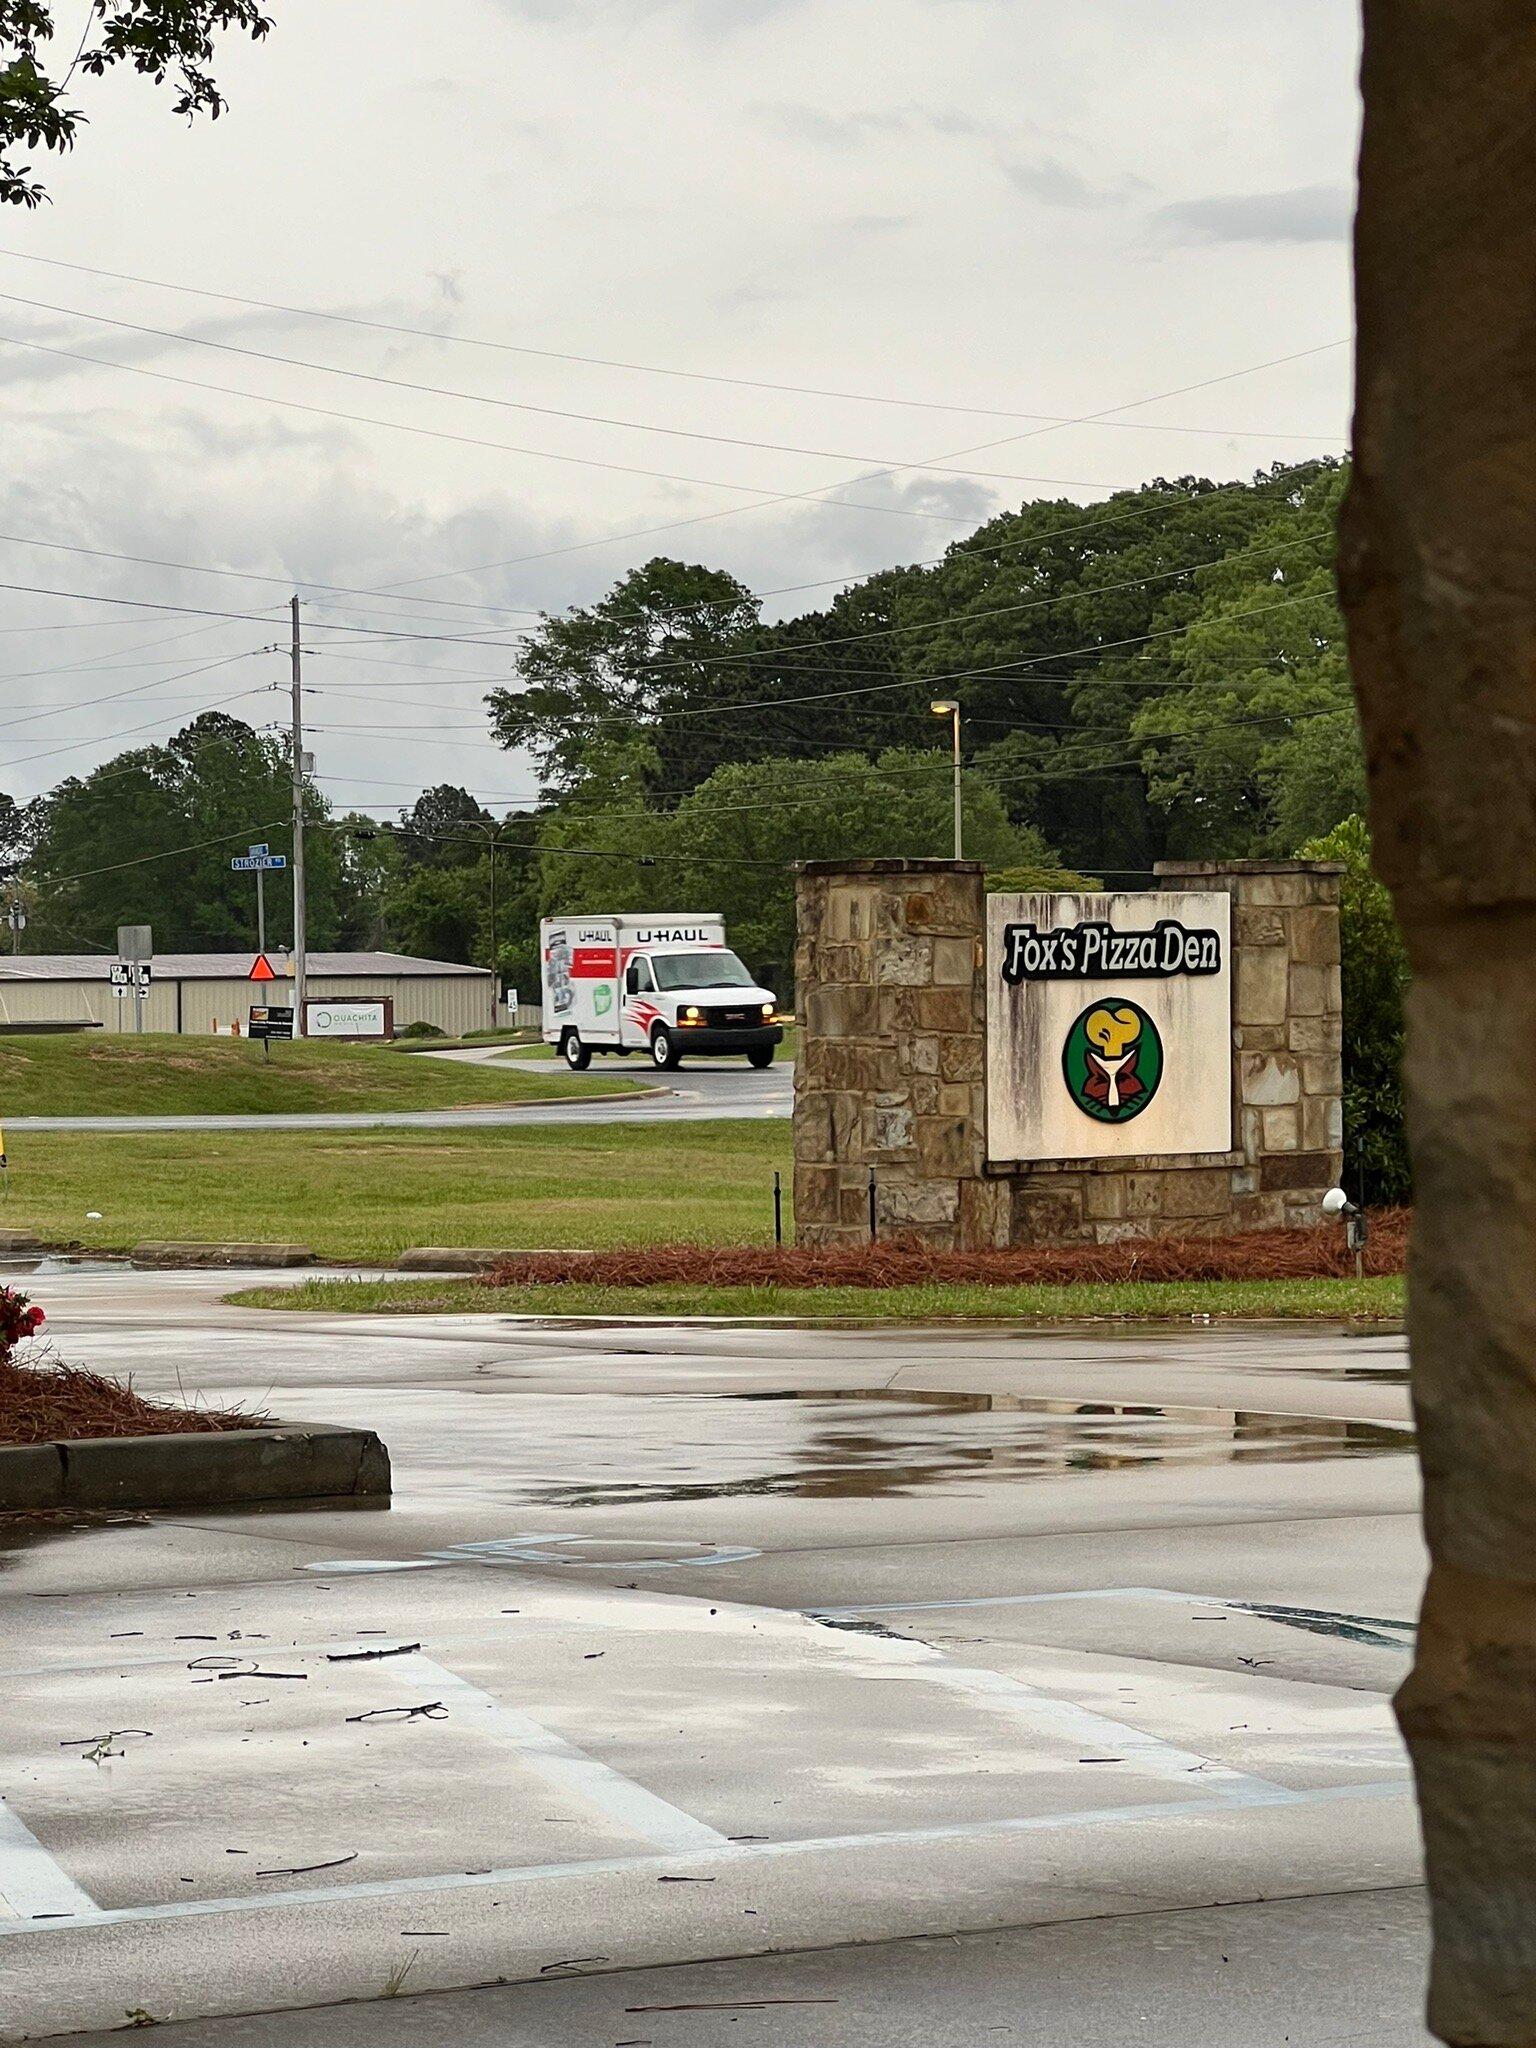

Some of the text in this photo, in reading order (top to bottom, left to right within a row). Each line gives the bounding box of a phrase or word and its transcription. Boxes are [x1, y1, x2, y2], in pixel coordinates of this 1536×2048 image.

[234, 859, 273, 868] STROZIER
[578, 930, 612, 942] U-HAUL
[637, 929, 709, 943] U-HAUL
[1009, 926, 1218, 976] Fox's Pizza Den
[333, 1014, 378, 1022] OUACHITA
